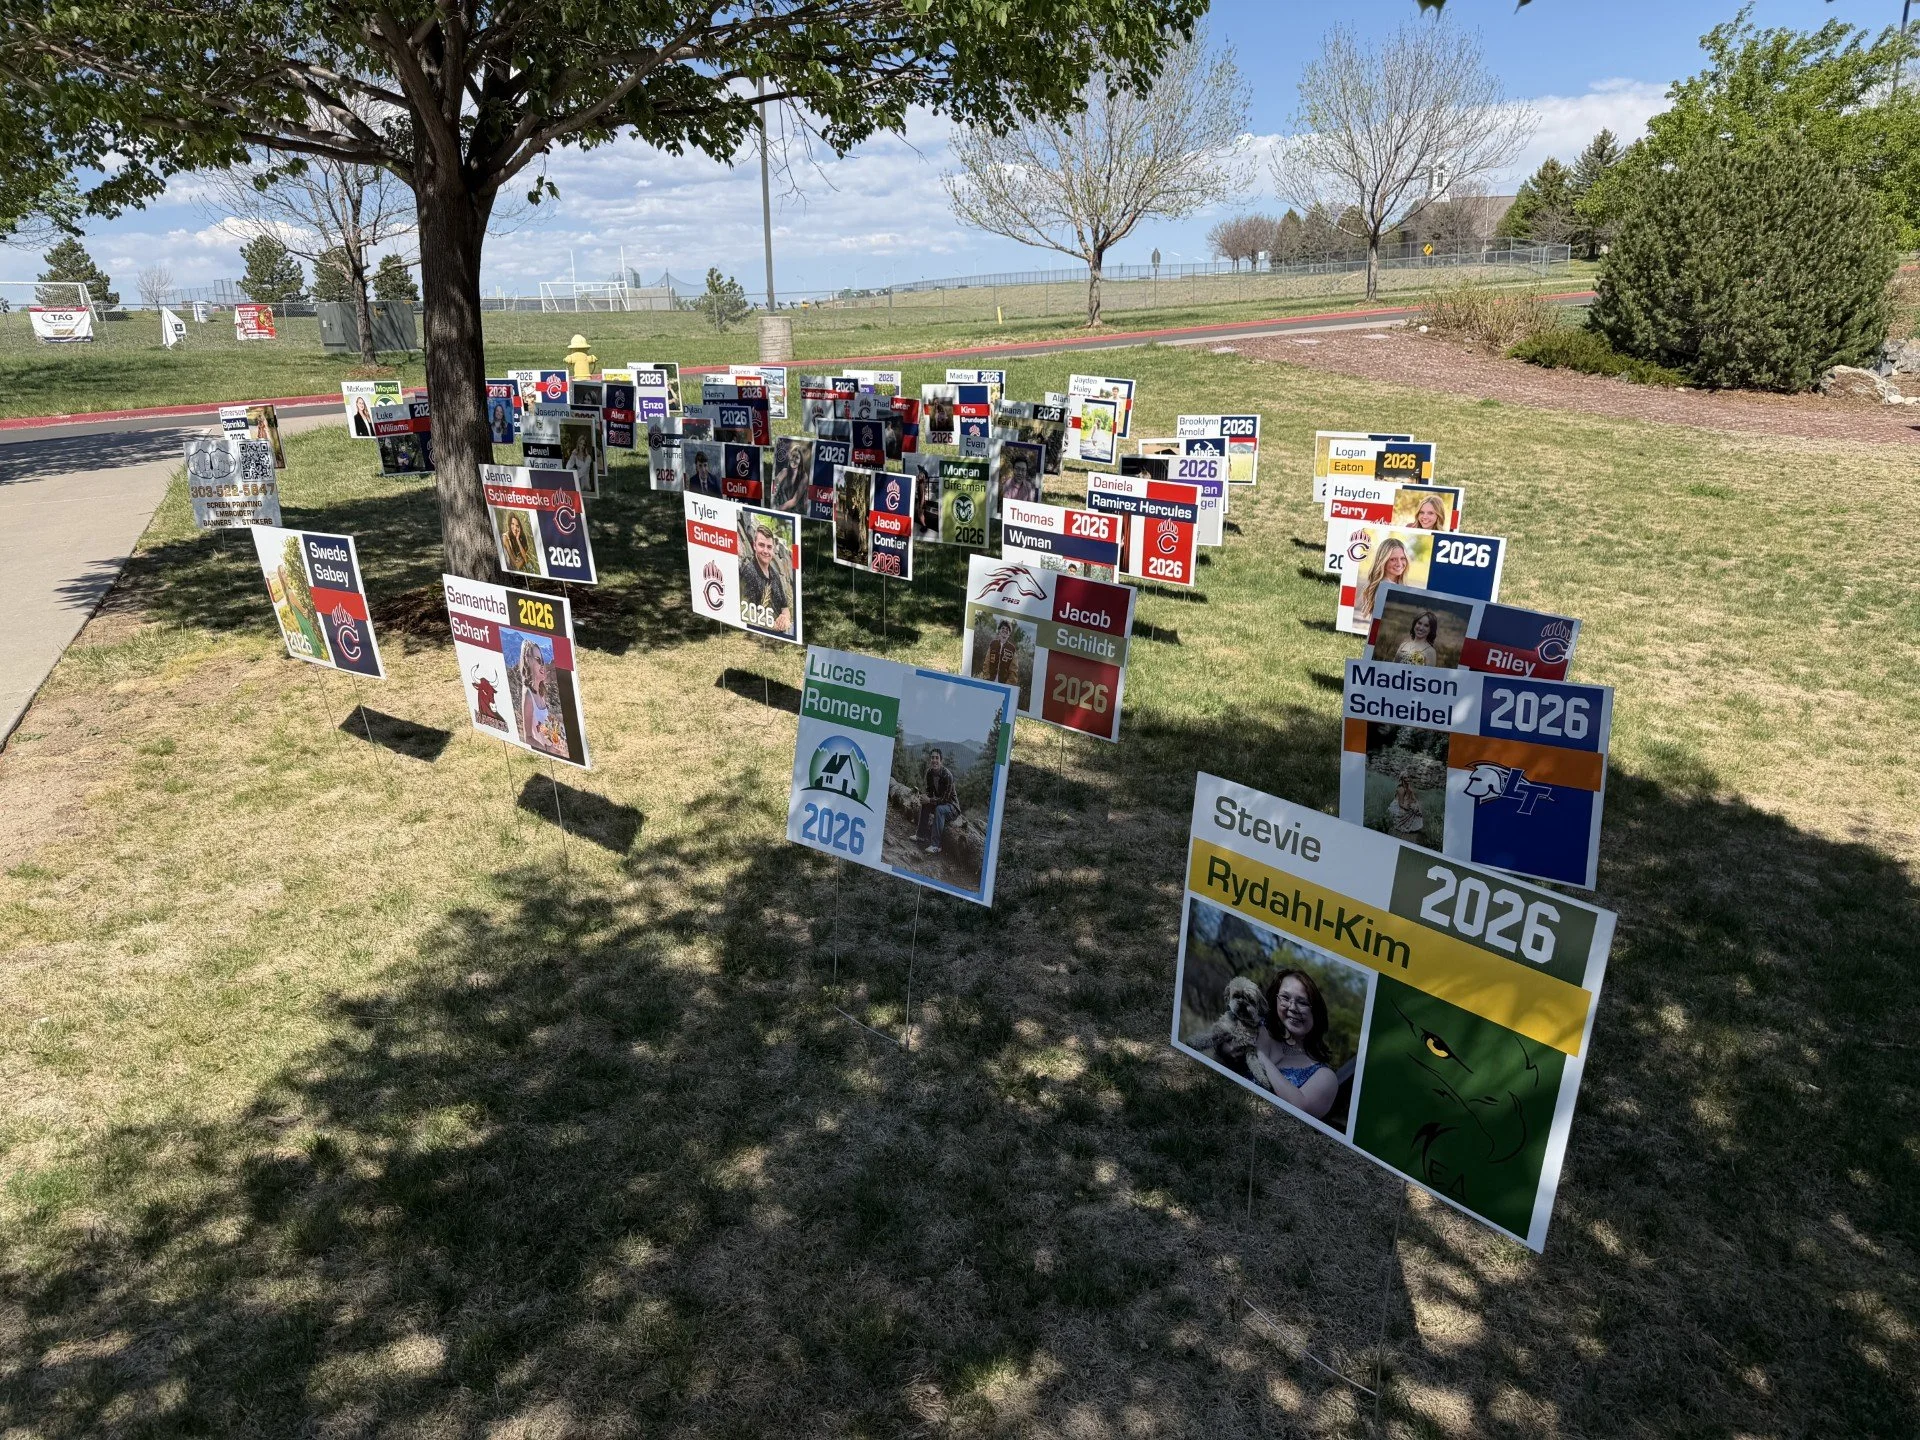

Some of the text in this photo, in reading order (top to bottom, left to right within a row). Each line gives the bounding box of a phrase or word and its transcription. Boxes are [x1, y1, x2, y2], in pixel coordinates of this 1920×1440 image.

[516, 372, 533, 381] 2026
[639, 373, 661, 385] 2026
[878, 373, 894, 382] 2026
[980, 371, 1000, 383] 2026
[346, 385, 374, 393] McKenna
[489, 386, 507, 397] 2026
[704, 387, 762, 399] Henry 2026
[835, 382, 855, 393] 2026
[376, 404, 430, 420] Luke 202
[535, 408, 570, 417] Josephina
[642, 400, 664, 409] Enzo
[873, 399, 910, 410] Thad Jeter
[960, 405, 976, 414] Kira
[220, 409, 246, 417] Emerson
[610, 411, 625, 419] Alex
[722, 410, 747, 426] 2026
[1037, 407, 1060, 421] 2026
[223, 421, 246, 429] Sprinkle
[378, 423, 409, 432] Williams
[1179, 417, 1253, 435] Brooklynn 2026
[1179, 427, 1205, 436] Arnold
[931, 432, 953, 443] 2026
[965, 437, 986, 449] Evan
[528, 446, 549, 456] Jewel
[819, 445, 846, 464] 2026
[1335, 447, 1417, 470] Logan 2026
[656, 468, 675, 481] 2026
[943, 464, 980, 478] Morgan
[1178, 459, 1218, 478] 2026
[1334, 461, 1364, 472] Eaton
[484, 469, 512, 483] Jenna
[1093, 476, 1133, 492] Daniela
[726, 482, 747, 494] Colin
[1334, 485, 1381, 501] Hayden
[206, 500, 262, 509] SCREEN PRINTING
[488, 488, 550, 506] Schieferecke
[692, 500, 718, 520] Tyler
[1092, 493, 1192, 519] Ramirez Hercules
[1332, 502, 1368, 519] Parry
[203, 519, 232, 527] BANNERS
[875, 516, 900, 531] Jacob
[1009, 507, 1109, 539] Thomas 2026
[693, 525, 734, 549] Sinclair
[874, 533, 907, 550] Contier
[955, 526, 984, 545] 2026
[1009, 529, 1052, 550] Wyman
[309, 541, 348, 562] Swede
[548, 546, 582, 568] 2026
[1435, 539, 1492, 568] 2026
[872, 552, 900, 576] 2026
[1149, 557, 1183, 579] 2026
[1328, 554, 1344, 570] 20
[314, 564, 349, 588] Sabey
[446, 585, 554, 630] Samantha 2026
[740, 600, 775, 629] 2026
[1059, 602, 1111, 629] Jacob
[452, 617, 490, 643] Scharf
[287, 631, 313, 653] 2026
[1056, 628, 1116, 658] Schildt
[808, 654, 866, 687] Lucas
[1486, 648, 1536, 678] Riley
[1052, 673, 1109, 714] 2026
[804, 686, 883, 726] Romero
[1349, 693, 1453, 726] Scheibel
[1351, 664, 1590, 740] Madison 2026
[801, 802, 866, 856] 2026
[1213, 795, 1322, 863] Stevie
[1206, 855, 1561, 970] Rydahl-Kim 2026
